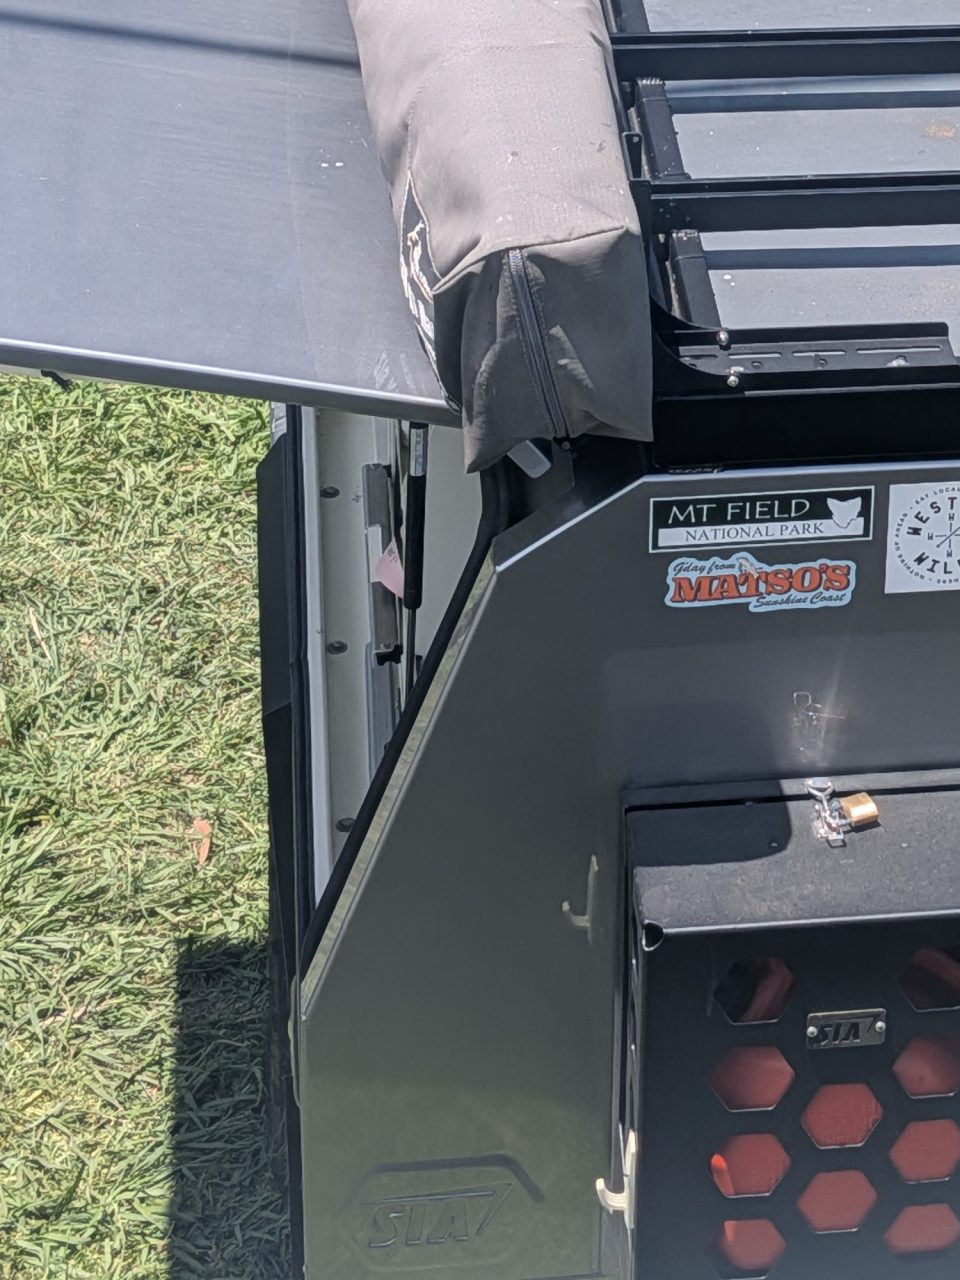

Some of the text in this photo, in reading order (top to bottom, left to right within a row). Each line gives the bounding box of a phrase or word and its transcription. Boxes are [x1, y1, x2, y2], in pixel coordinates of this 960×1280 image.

[933, 486, 960, 496] LOCAL
[668, 499, 810, 524] MT FIELD
[685, 522, 824, 542] NATIONAL PARK
[707, 561, 737, 575] from
[671, 563, 851, 603] MATSO'S
[754, 591, 846, 609] Sunshine Coast
